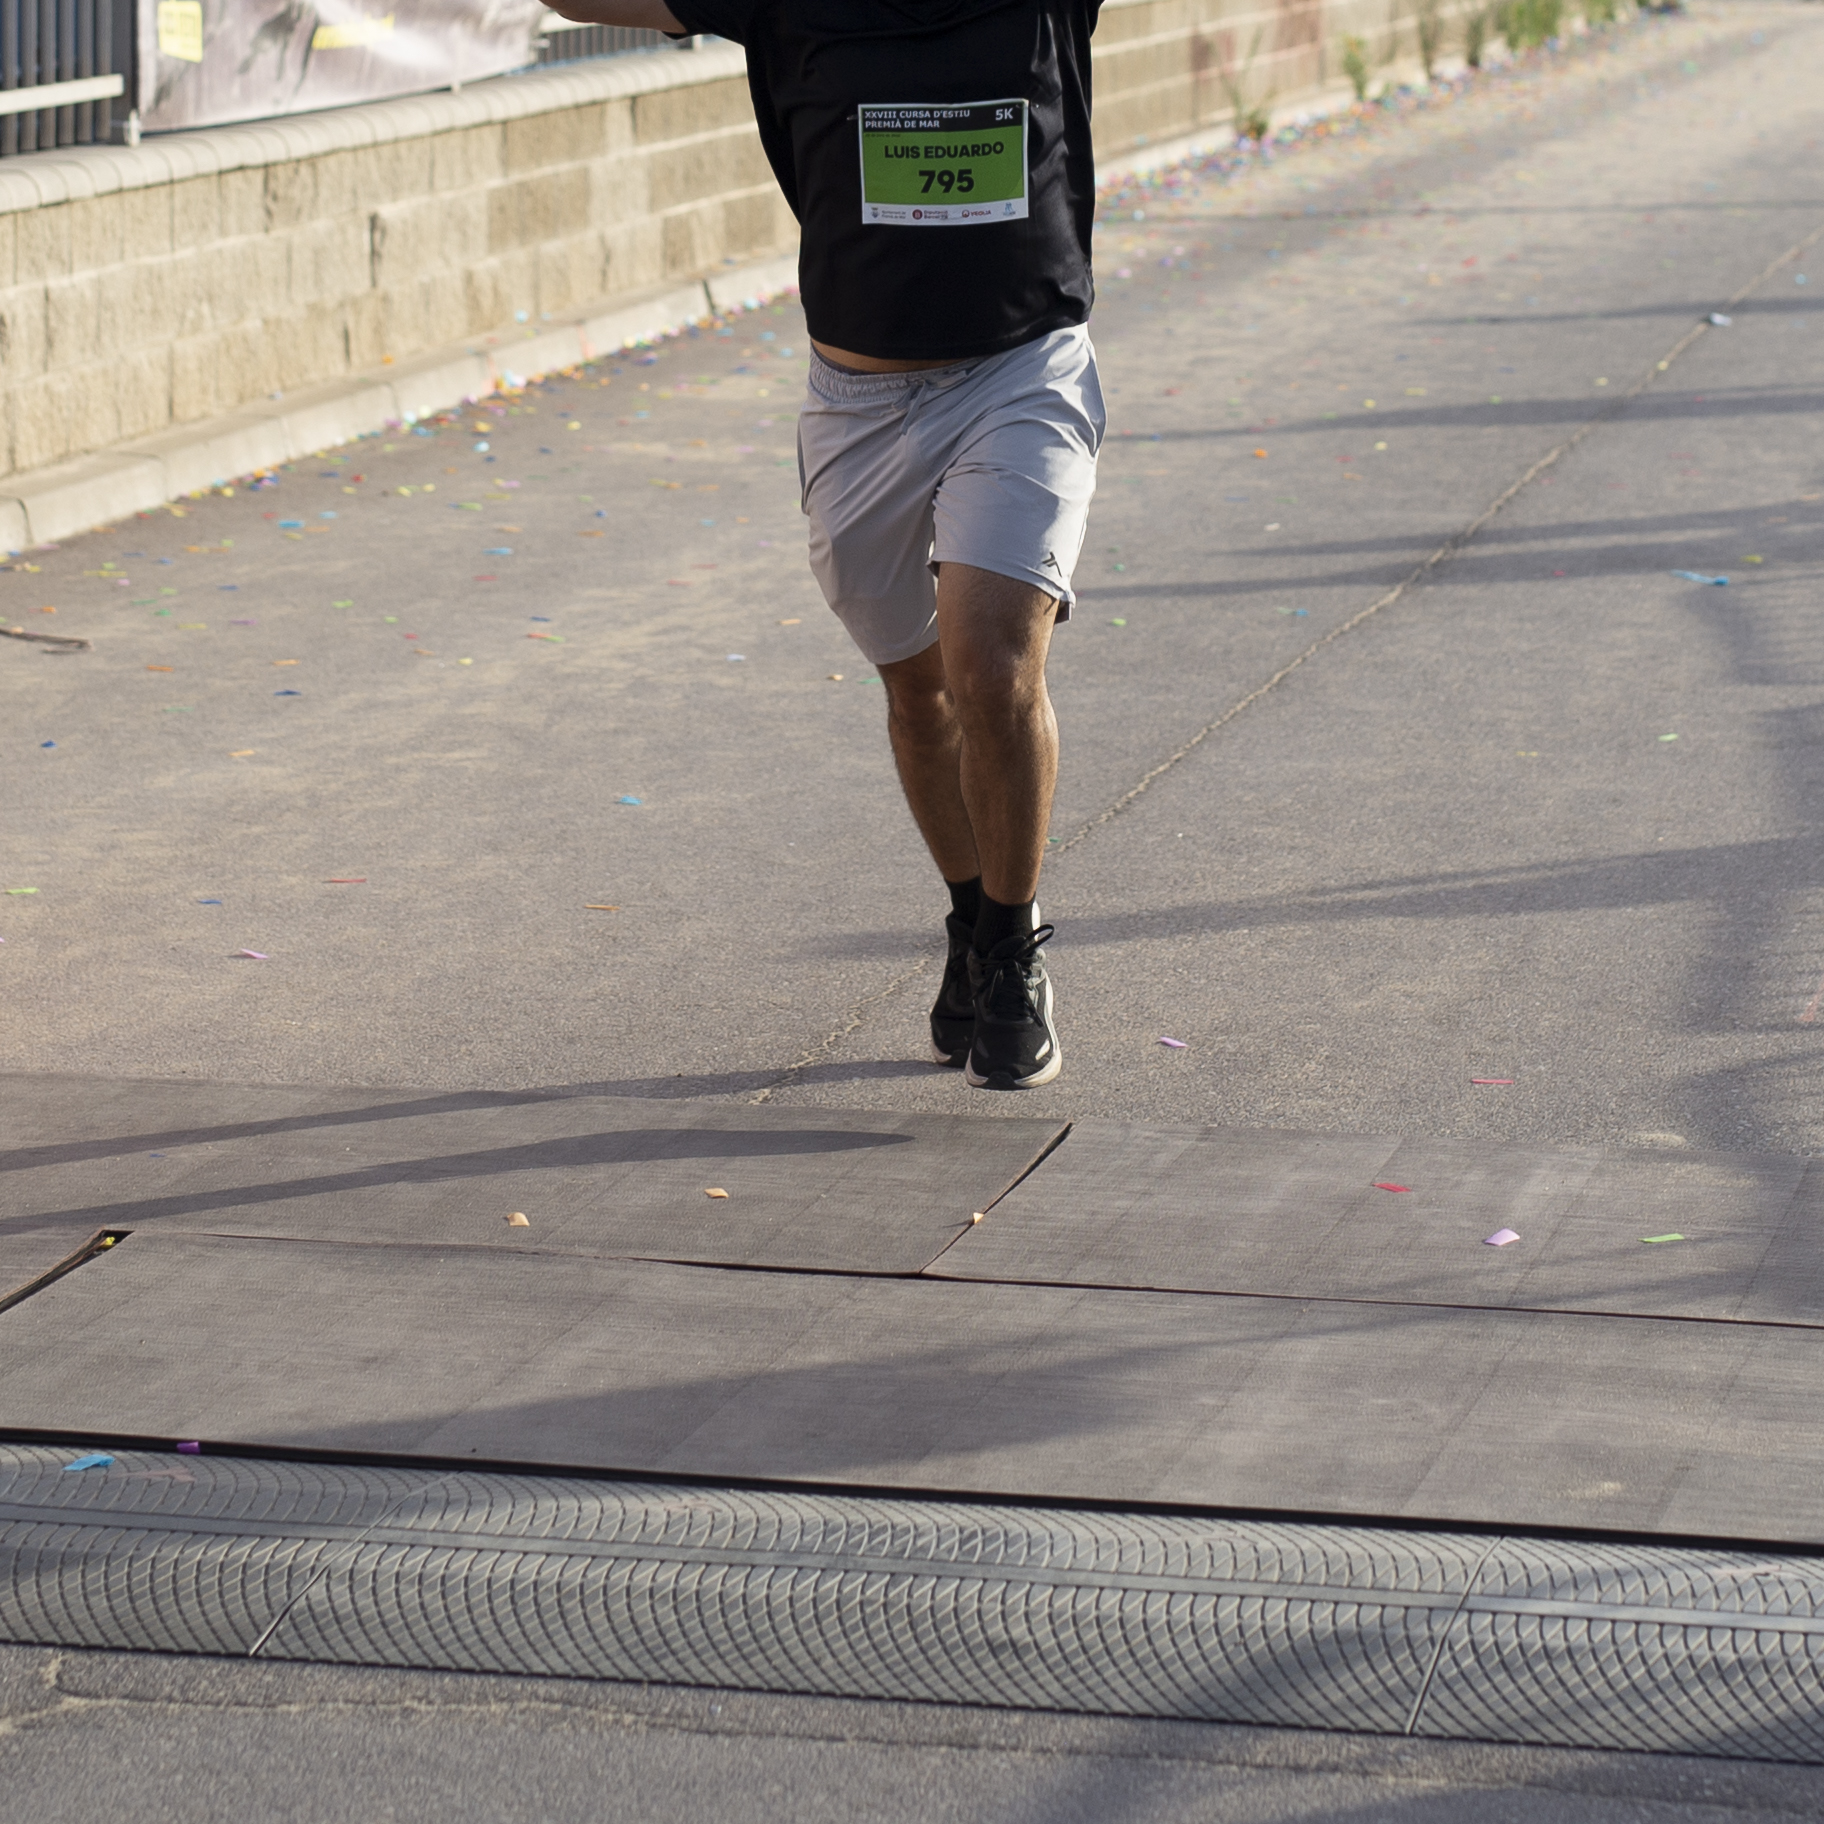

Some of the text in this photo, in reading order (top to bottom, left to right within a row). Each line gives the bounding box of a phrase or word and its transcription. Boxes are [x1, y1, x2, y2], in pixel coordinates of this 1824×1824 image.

[864, 107, 1014, 121] XXVIII CURSA D'ESTIU 5K
[865, 118, 940, 129] PREMIÀ DE MAR
[884, 141, 1005, 159] LUIS EDUARDO
[918, 168, 975, 194] 795
